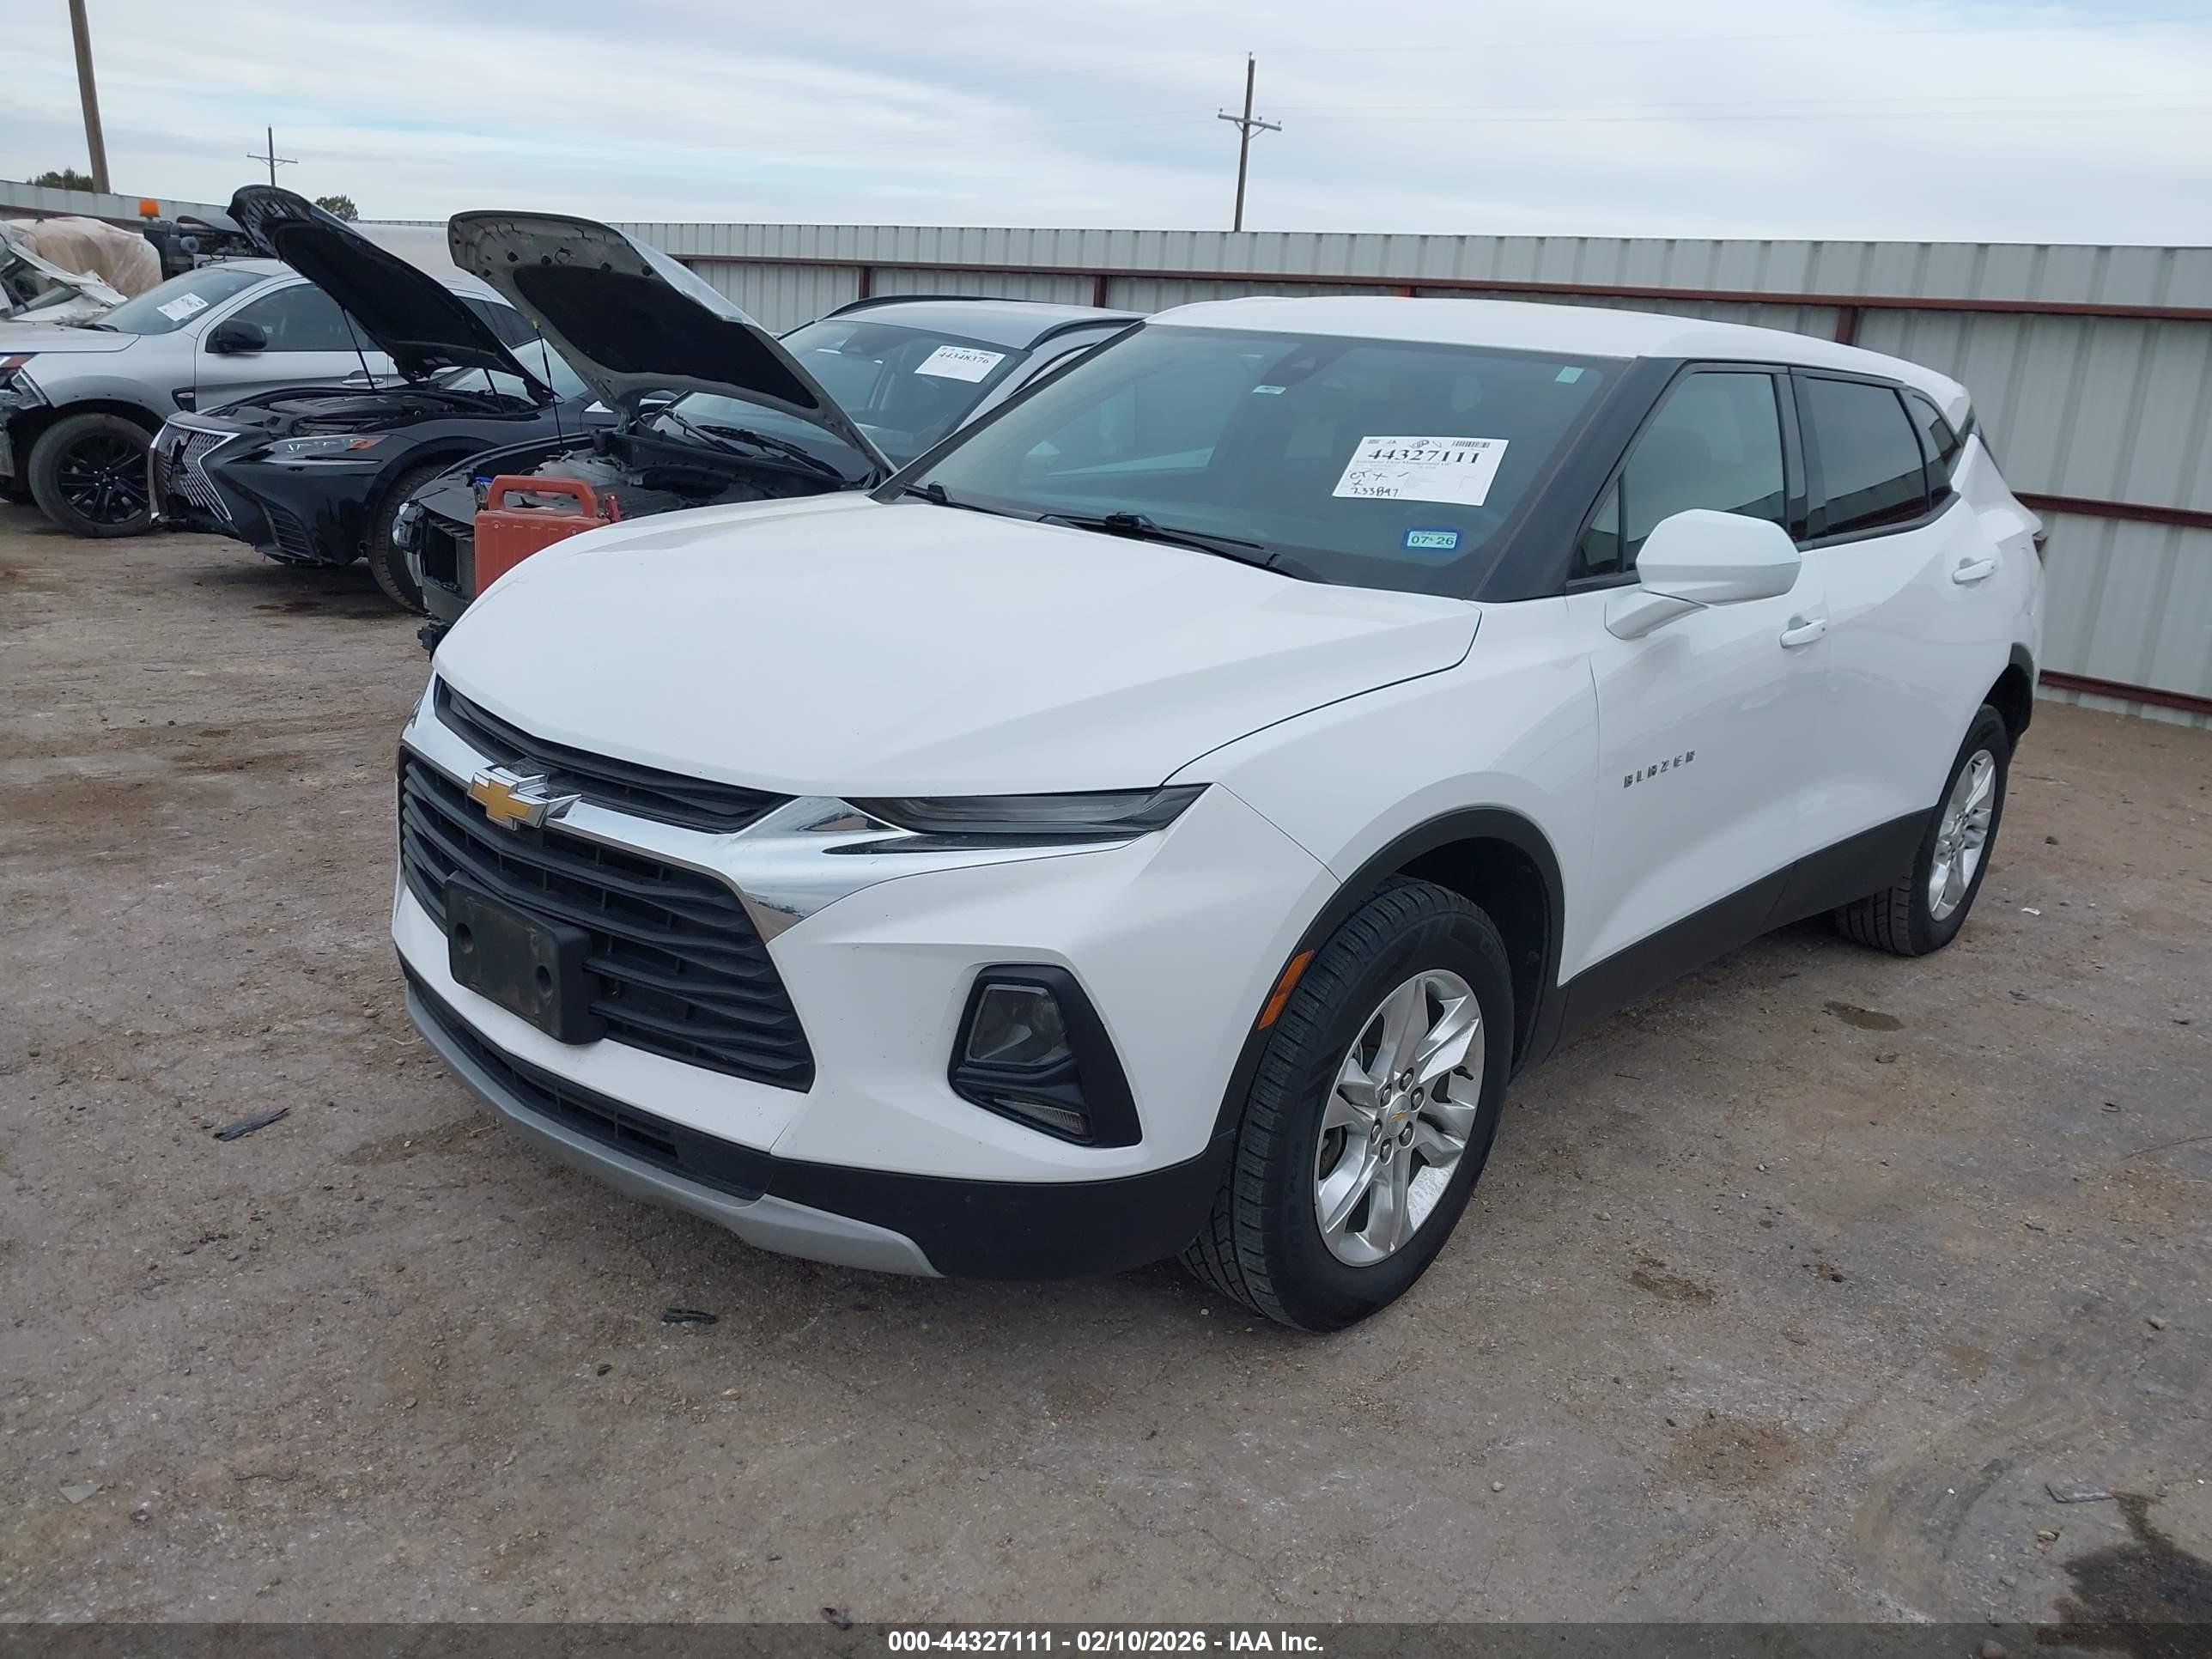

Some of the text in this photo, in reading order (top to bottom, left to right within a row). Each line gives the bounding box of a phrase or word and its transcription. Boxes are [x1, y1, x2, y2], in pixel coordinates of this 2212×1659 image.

[1367, 448, 1480, 464] 44327111
[1411, 535, 1455, 545] 07 26
[1624, 750, 1696, 788] BLAZER
